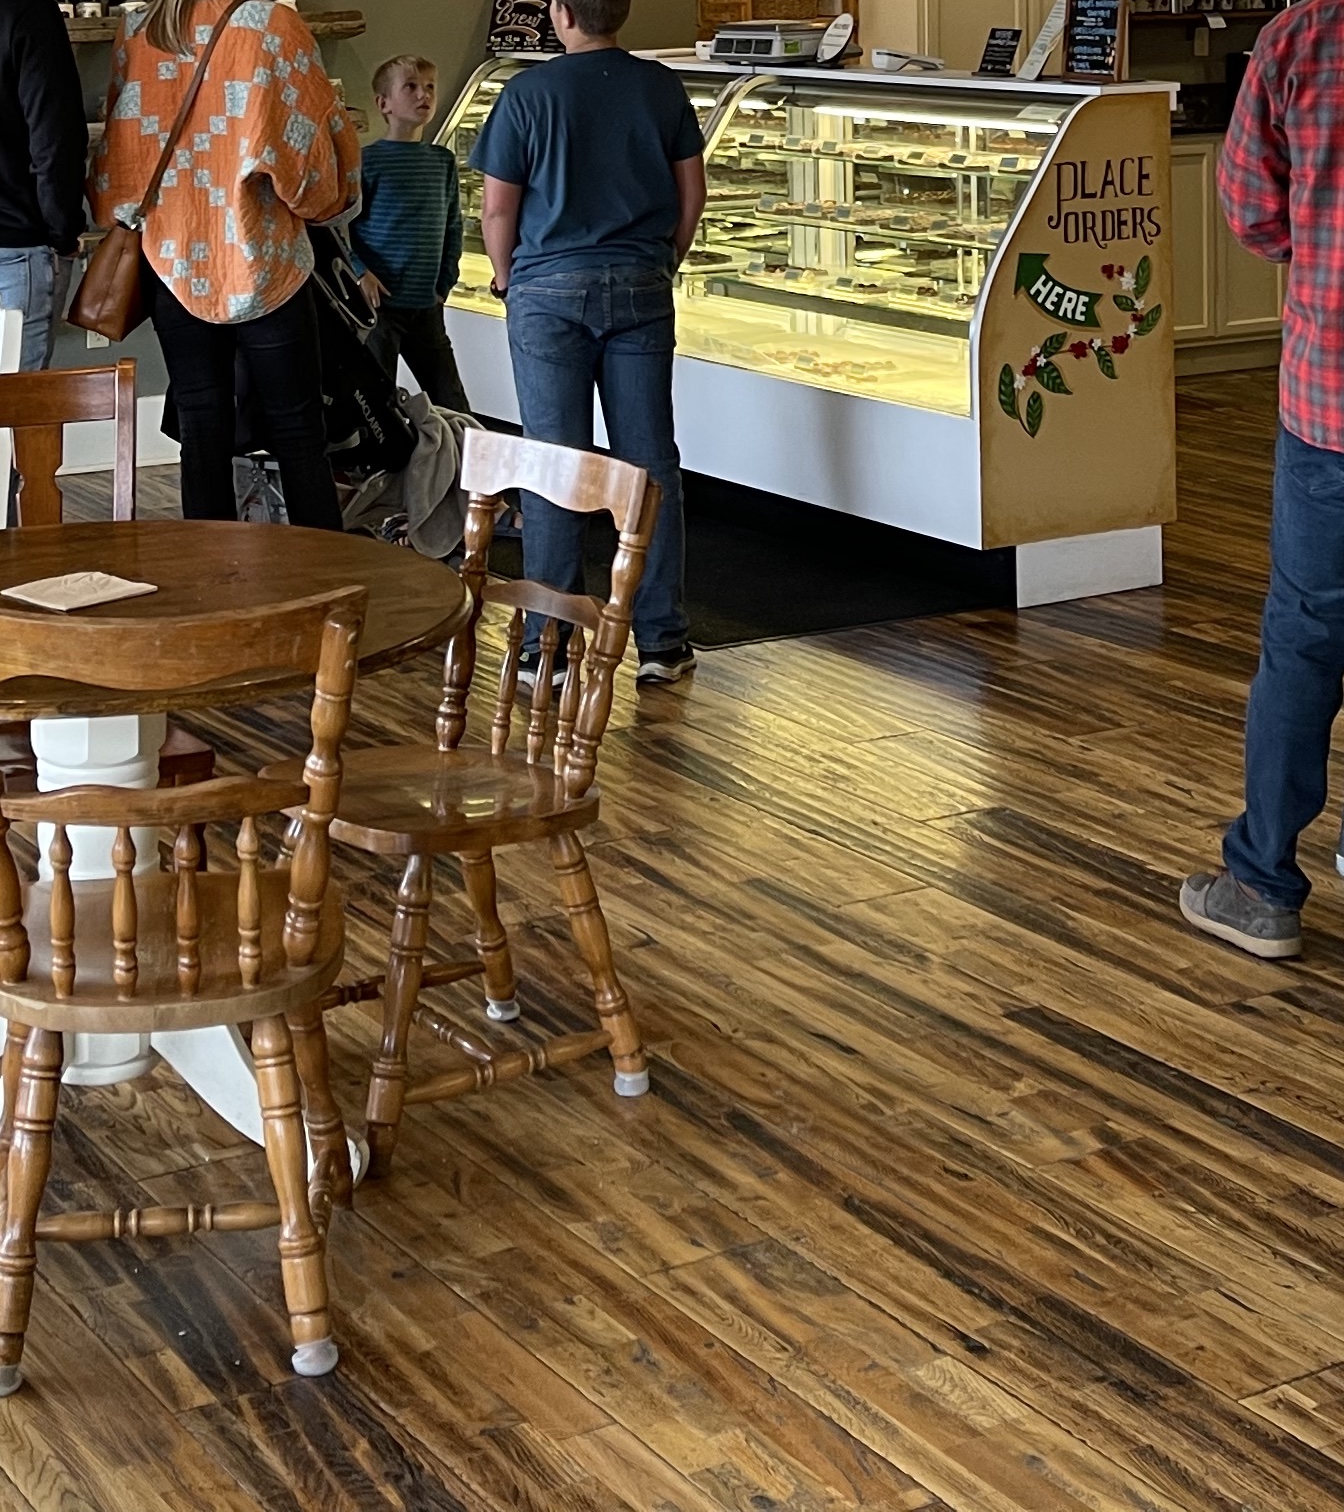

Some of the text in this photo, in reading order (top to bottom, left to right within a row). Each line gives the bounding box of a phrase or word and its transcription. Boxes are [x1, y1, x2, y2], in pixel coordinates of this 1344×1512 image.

[1048, 156, 1154, 230] PLACE
[1063, 206, 1162, 250] ORDERS
[1030, 274, 1089, 322] HERE
